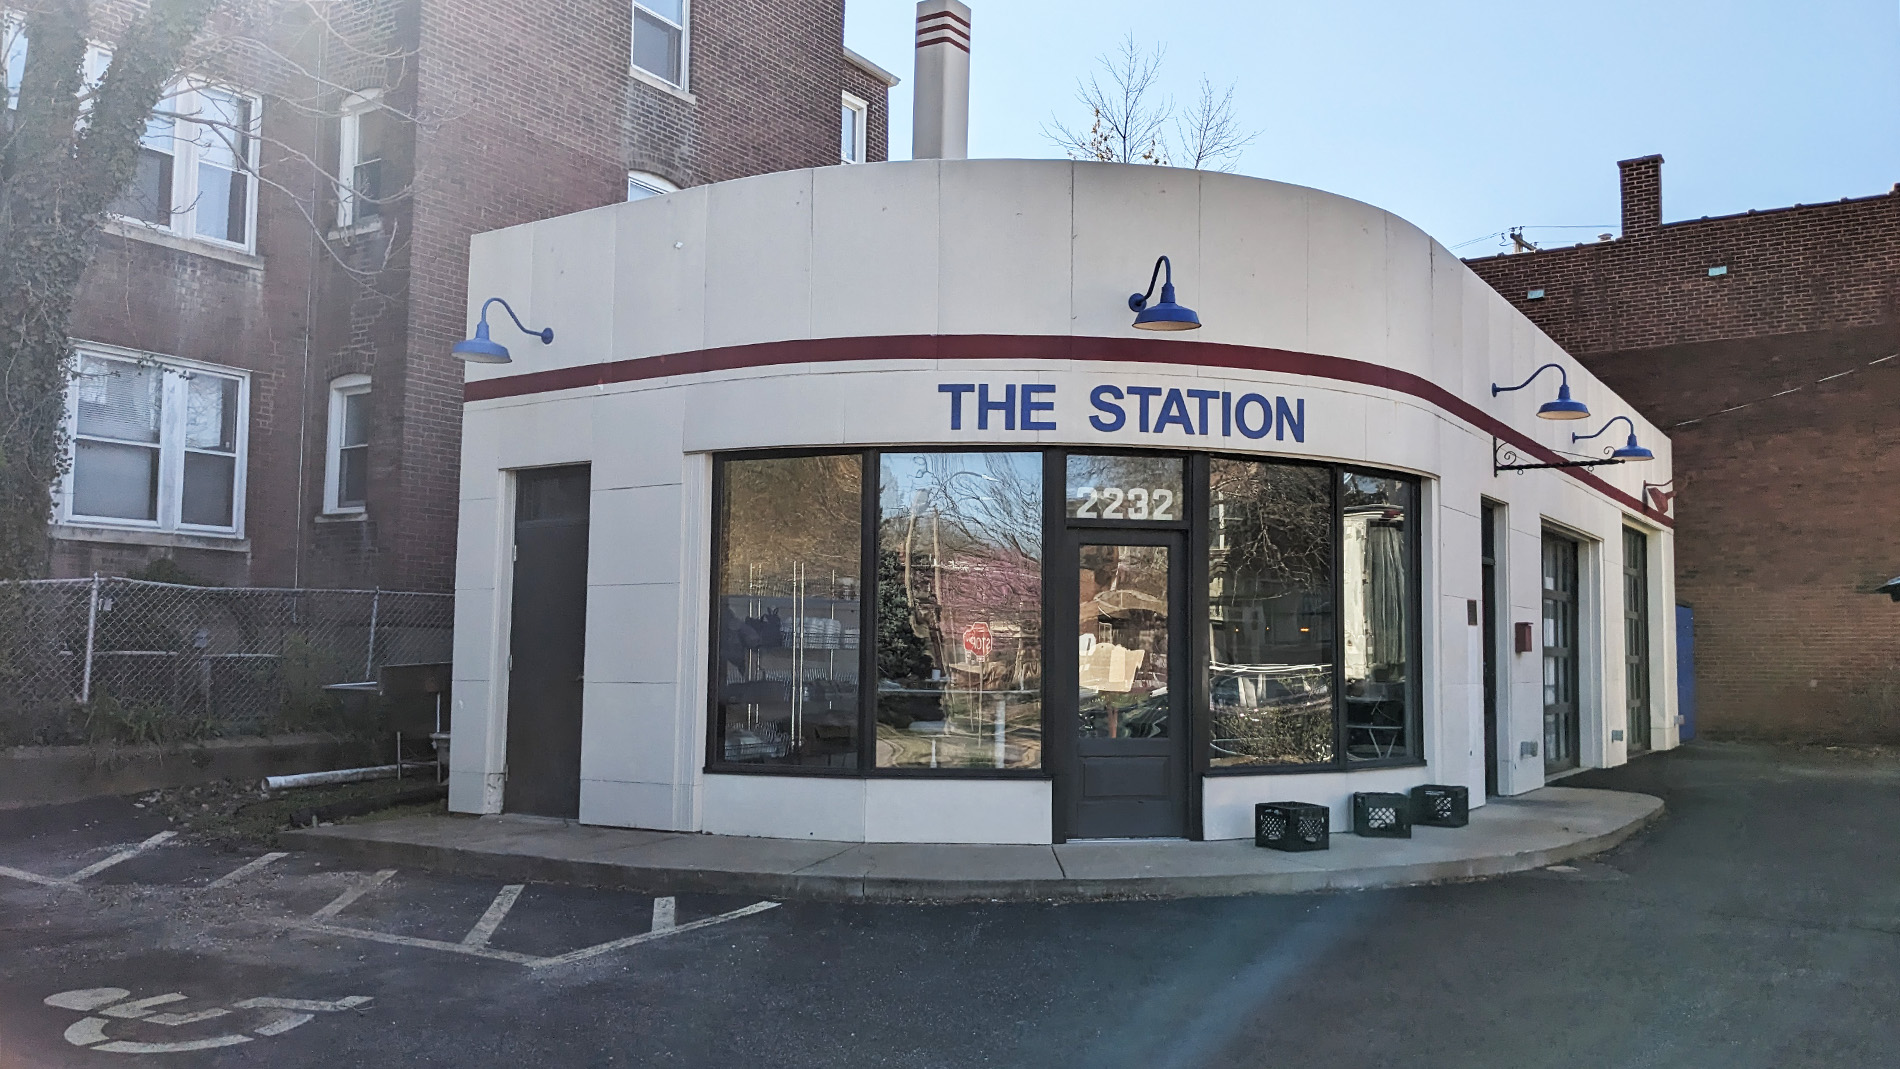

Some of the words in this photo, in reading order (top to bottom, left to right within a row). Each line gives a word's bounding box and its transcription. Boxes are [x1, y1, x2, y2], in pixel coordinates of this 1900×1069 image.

[938, 384, 1056, 430] THE
[1089, 385, 1304, 443] STATION
[1077, 487, 1173, 520] 2232
